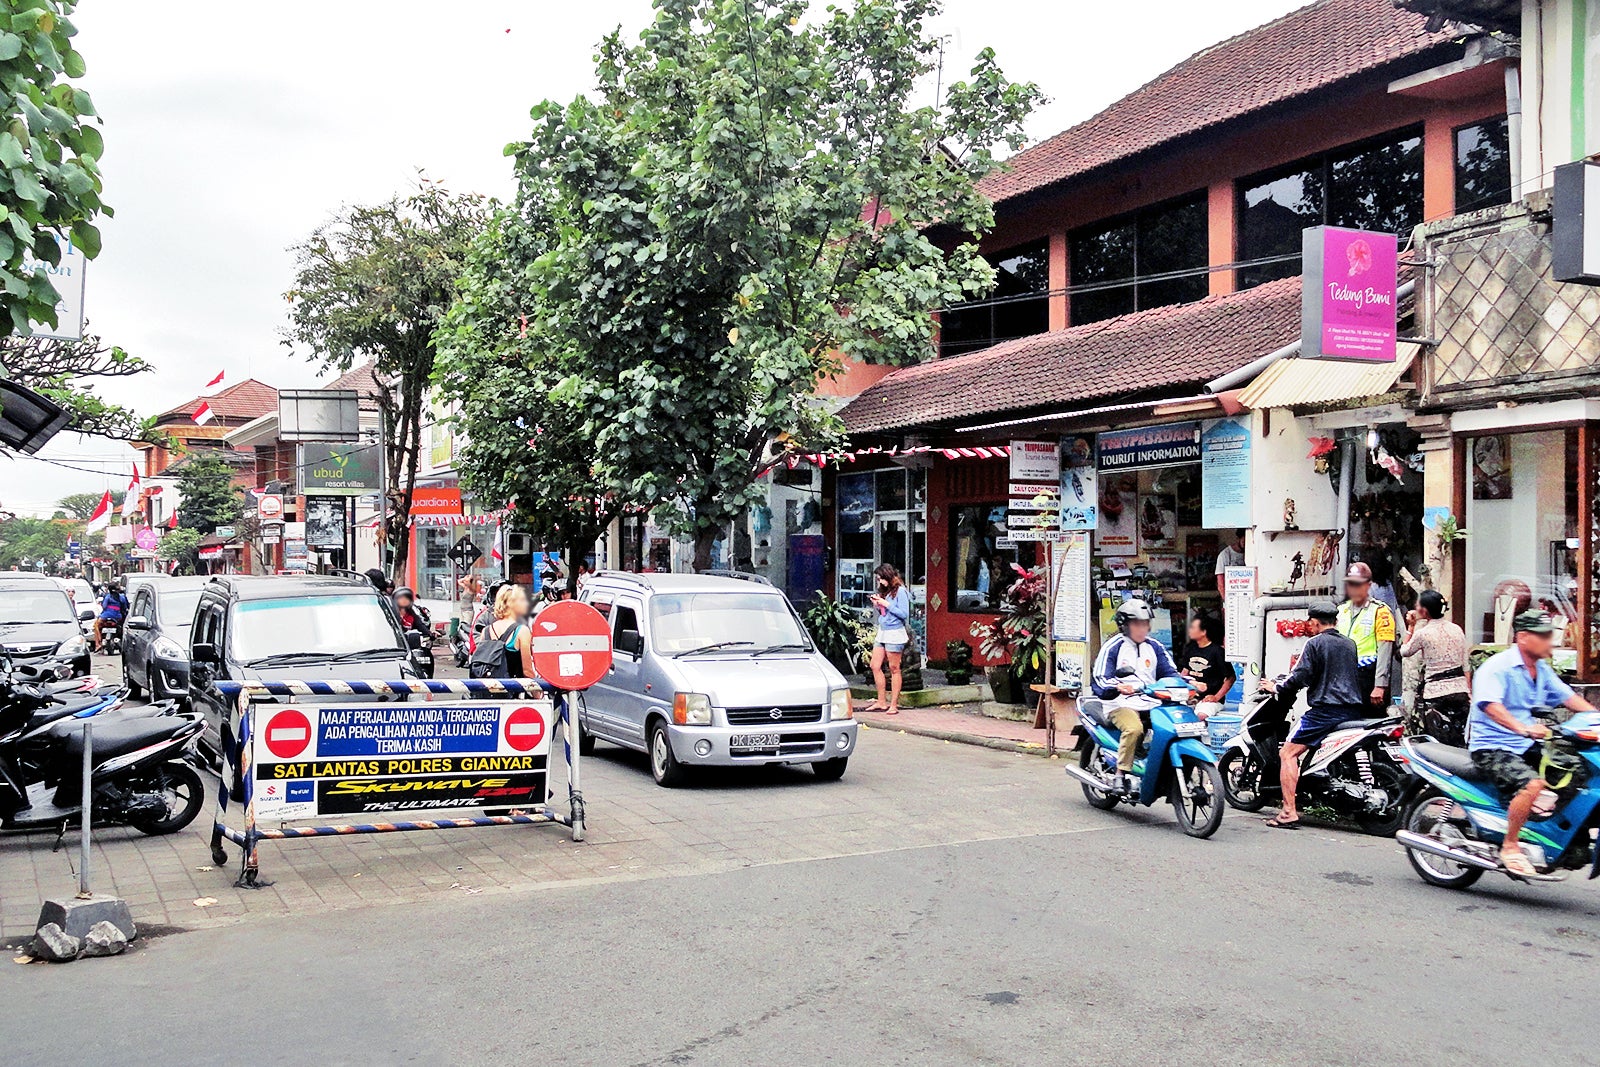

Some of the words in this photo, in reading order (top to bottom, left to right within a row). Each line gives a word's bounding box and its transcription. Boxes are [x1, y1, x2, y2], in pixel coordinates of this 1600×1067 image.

[1328, 282, 1362, 309] Tedung
[1365, 287, 1391, 306] Bumi
[1102, 451, 1135, 466] TOURIST
[1137, 445, 1200, 463] INFORMATION
[313, 467, 343, 478] ubud
[320, 711, 353, 725] MAAF
[354, 710, 417, 723] PERJALANAN
[418, 710, 444, 722] ANDA
[446, 709, 498, 722] TERGANGGU
[324, 726, 347, 739] ADA
[348, 725, 408, 738] PENGALIHAN
[409, 724, 434, 737] ARUS
[435, 724, 459, 737] LALU
[460, 723, 492, 736] LINTAS
[377, 739, 413, 753] TERIMA
[414, 738, 442, 752] KASIH
[273, 763, 308, 779] SAT
[312, 761, 380, 778] LANTAS
[388, 758, 452, 775] POLRES
[460, 755, 533, 771] GIANYAR
[363, 801, 399, 811] THE
[399, 797, 486, 809] ULTIMATIC
